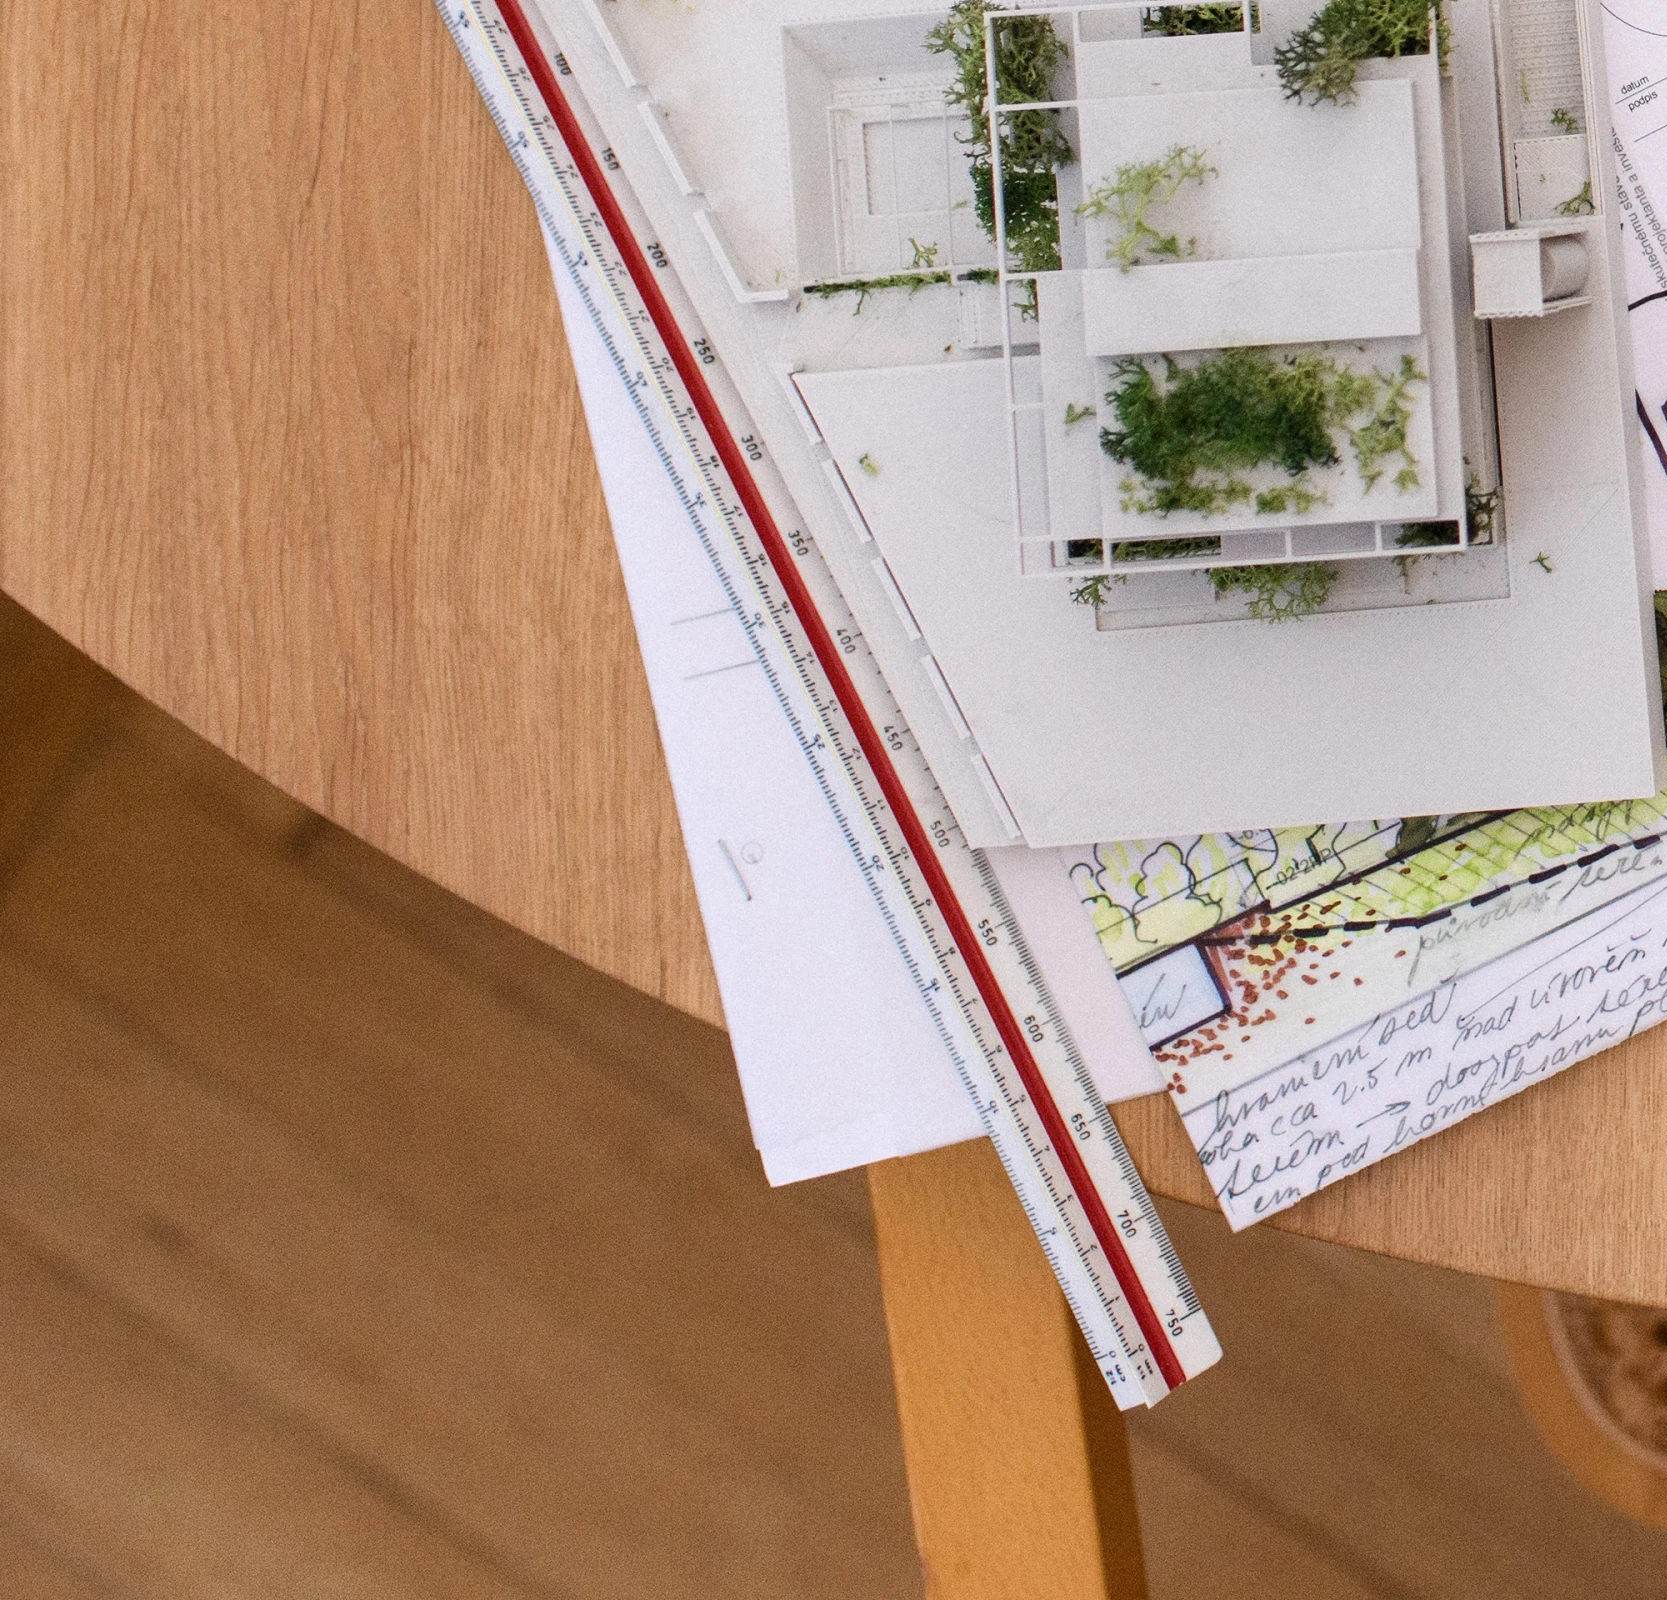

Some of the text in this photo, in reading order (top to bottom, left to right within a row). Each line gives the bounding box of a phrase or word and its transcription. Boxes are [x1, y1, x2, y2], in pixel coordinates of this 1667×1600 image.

[1620, 76, 1649, 95] datum
[1628, 91, 1658, 112] podpis
[598, 144, 622, 173] 150
[645, 240, 670, 271] 200
[692, 335, 717, 366] 250
[739, 432, 763, 463] 300
[785, 528, 810, 559] 350
[752, 610, 767, 629] 30
[833, 625, 857, 656] 400
[811, 731, 827, 750] 25
[880, 721, 905, 753] 450
[927, 819, 951, 850] 500
[974, 917, 999, 949] 550
[928, 975, 942, 992] 15
[1020, 1013, 1045, 1044] 600
[987, 1097, 1001, 1115] 10
[1067, 1111, 1093, 1143] 650
[1114, 1209, 1139, 1240] 700
[1161, 1307, 1186, 1338] 750
